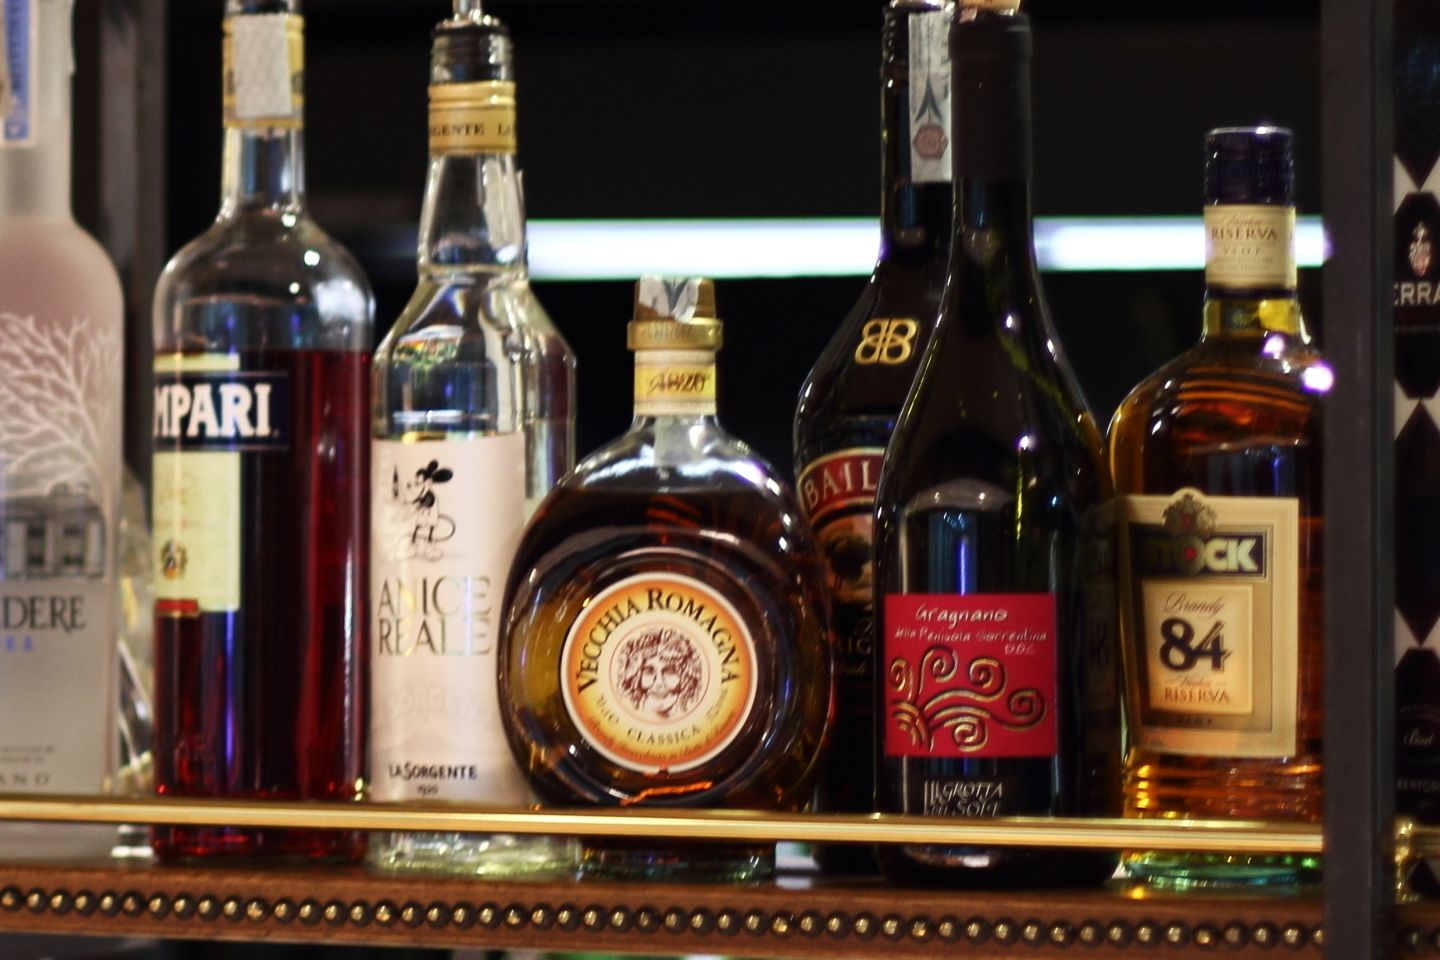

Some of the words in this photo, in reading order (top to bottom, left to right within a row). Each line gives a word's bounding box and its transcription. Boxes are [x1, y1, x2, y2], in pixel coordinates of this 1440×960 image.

[1211, 227, 1277, 240] RISERVA
[378, 576, 492, 616] ANICE
[1163, 593, 1224, 619] Brandy
[916, 603, 1009, 629] Gragnano
[379, 617, 492, 656] REALE
[577, 597, 641, 694] VECCHIA
[646, 588, 741, 684] ROMAGNA
[1160, 617, 1232, 673] 84
[1164, 688, 1229, 704] RISERVA
[626, 725, 702, 745] CLASSICA
